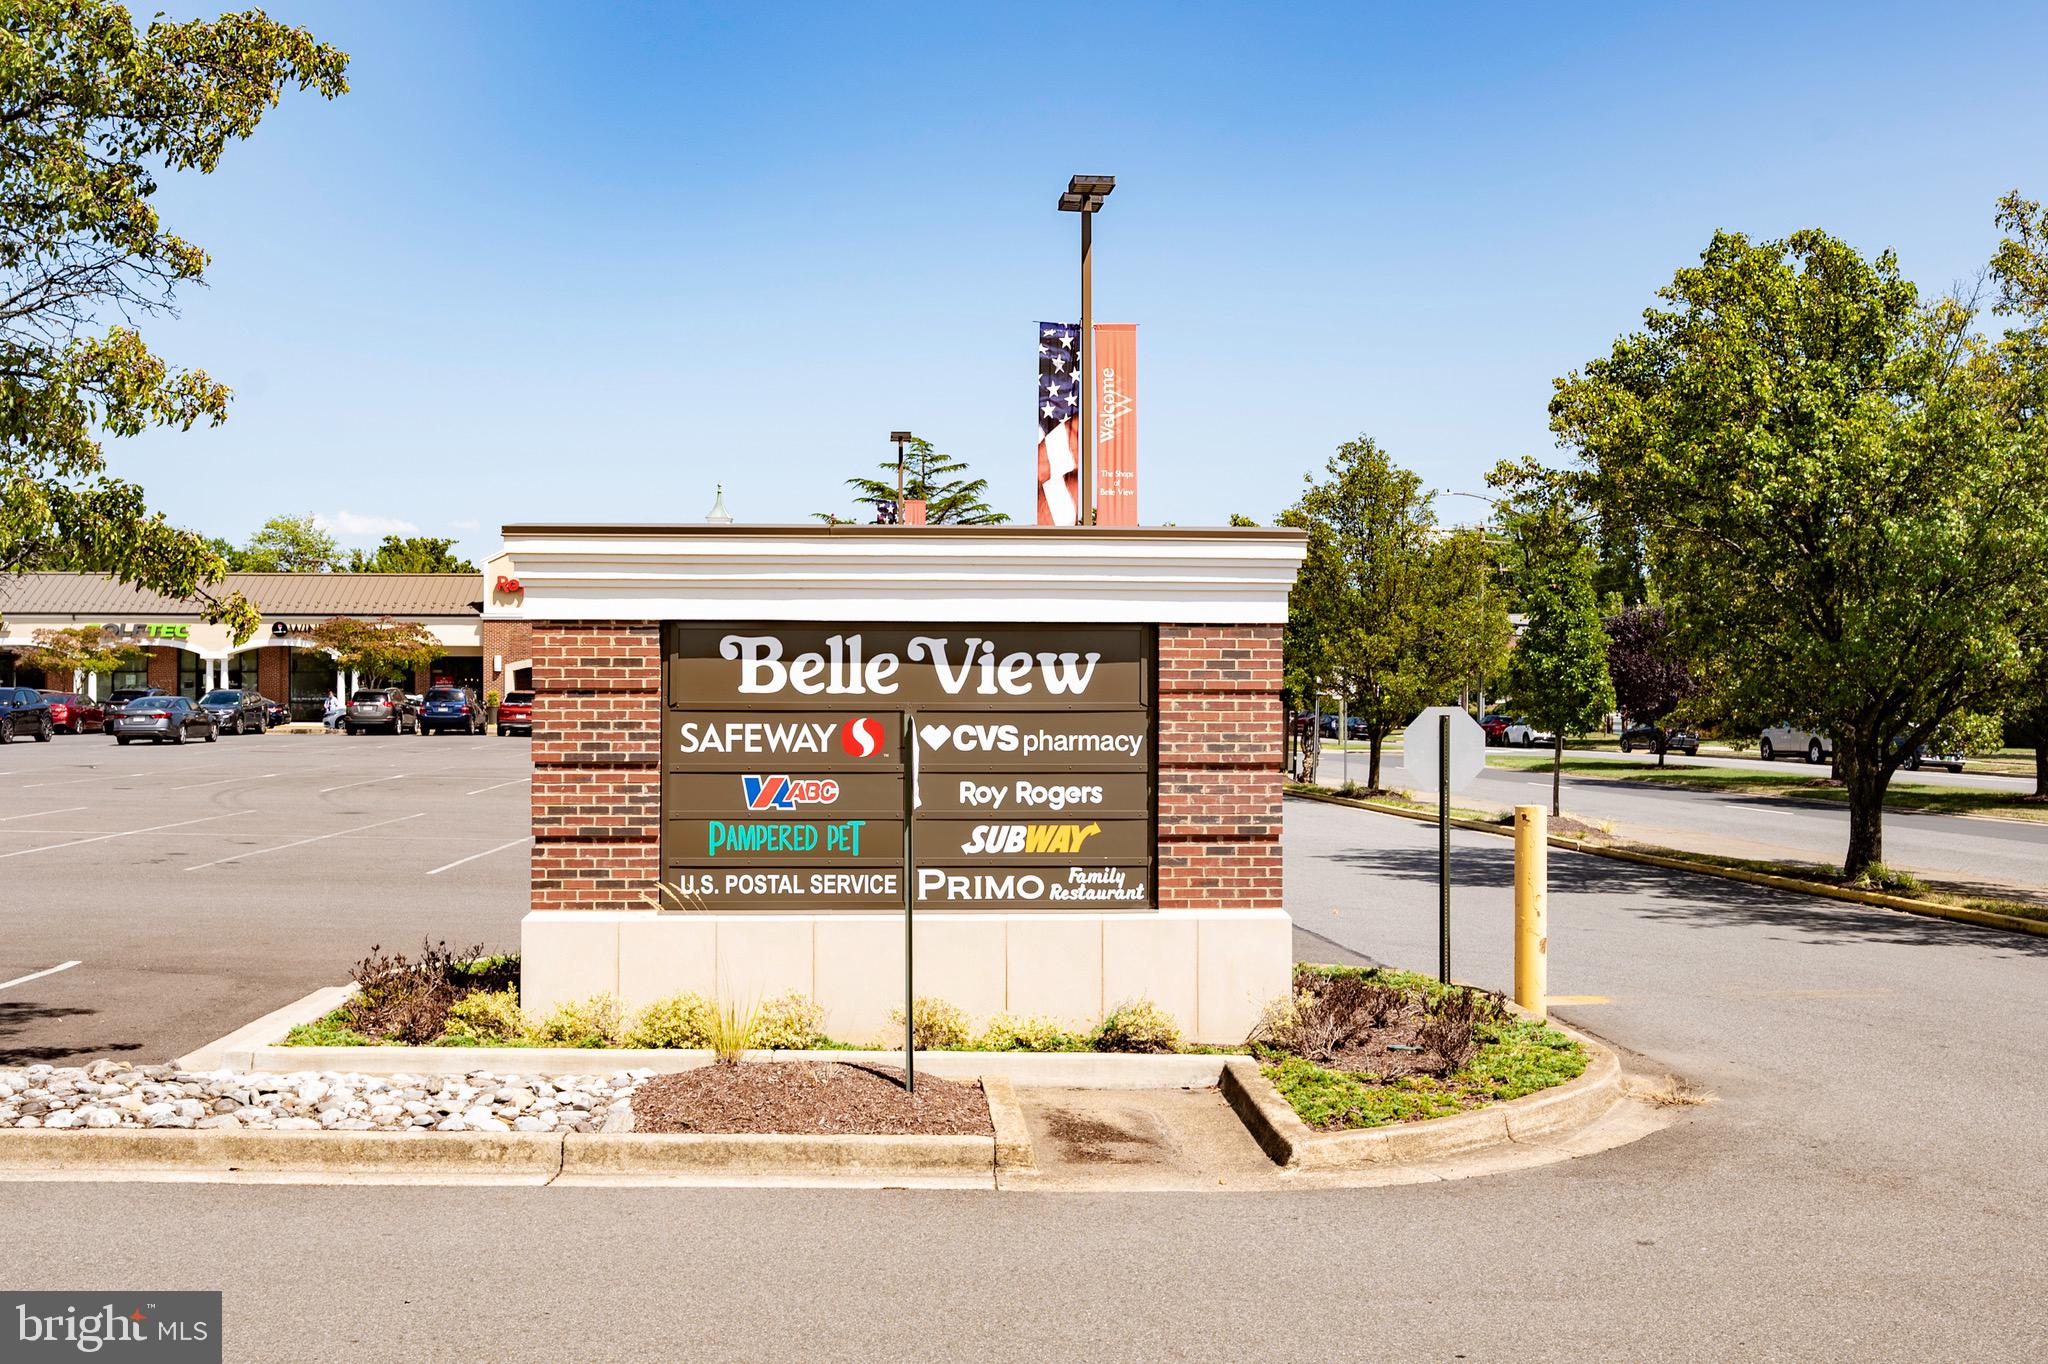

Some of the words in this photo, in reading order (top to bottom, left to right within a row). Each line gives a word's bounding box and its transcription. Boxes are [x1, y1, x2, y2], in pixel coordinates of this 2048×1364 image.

[1099, 367, 1115, 443] Welcome
[1101, 470, 1114, 478] The
[719, 634, 900, 695] Belle
[907, 636, 1101, 695] View
[680, 722, 837, 753] SAFEWAY
[952, 724, 1019, 752] CVS
[1023, 730, 1144, 756] pharmacy
[959, 780, 1008, 809] Roy
[1016, 780, 1103, 811] Rogers
[960, 822, 1102, 855] SUBWAY
[680, 874, 719, 895] U.S.
[725, 874, 805, 895] POSTAL
[810, 874, 897, 895] SERVICE
[917, 868, 1045, 900] PRIMO
[1049, 882, 1145, 901] Restaurant
[1068, 867, 1126, 889] Family
